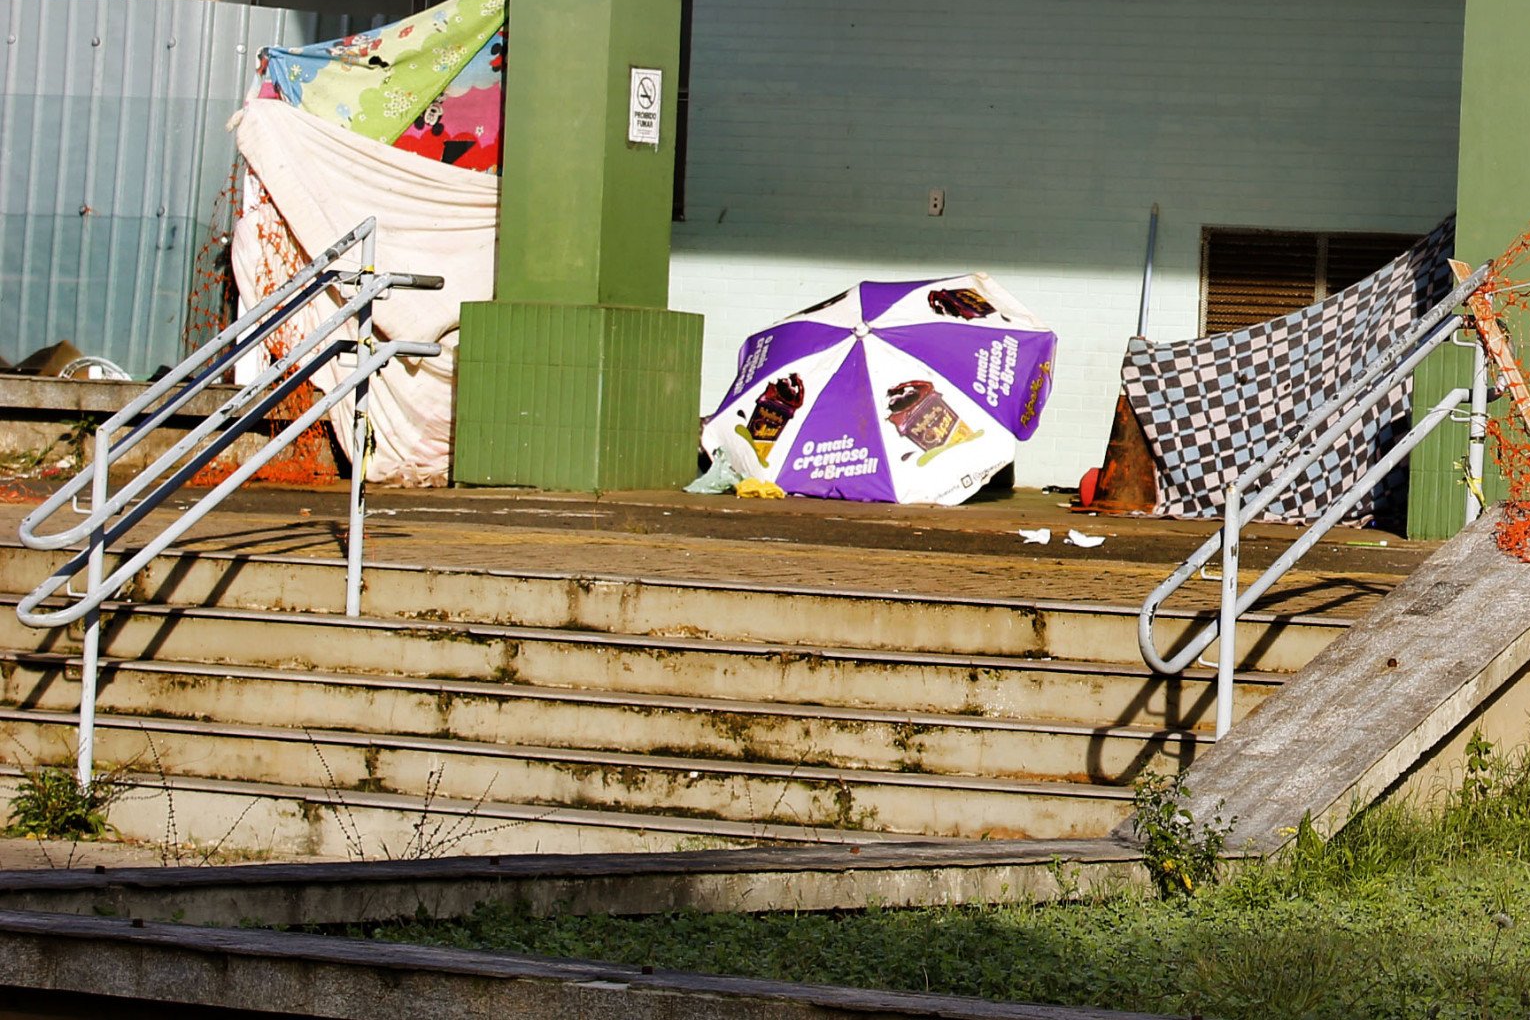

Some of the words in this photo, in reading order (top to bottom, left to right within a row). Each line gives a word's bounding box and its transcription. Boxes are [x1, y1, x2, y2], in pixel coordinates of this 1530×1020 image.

[974, 348, 989, 383] mais
[986, 340, 1003, 407] cremoso
[972, 381, 986, 395] O
[802, 440, 815, 456] O
[816, 434, 855, 454] mais
[793, 447, 869, 471] cremoso
